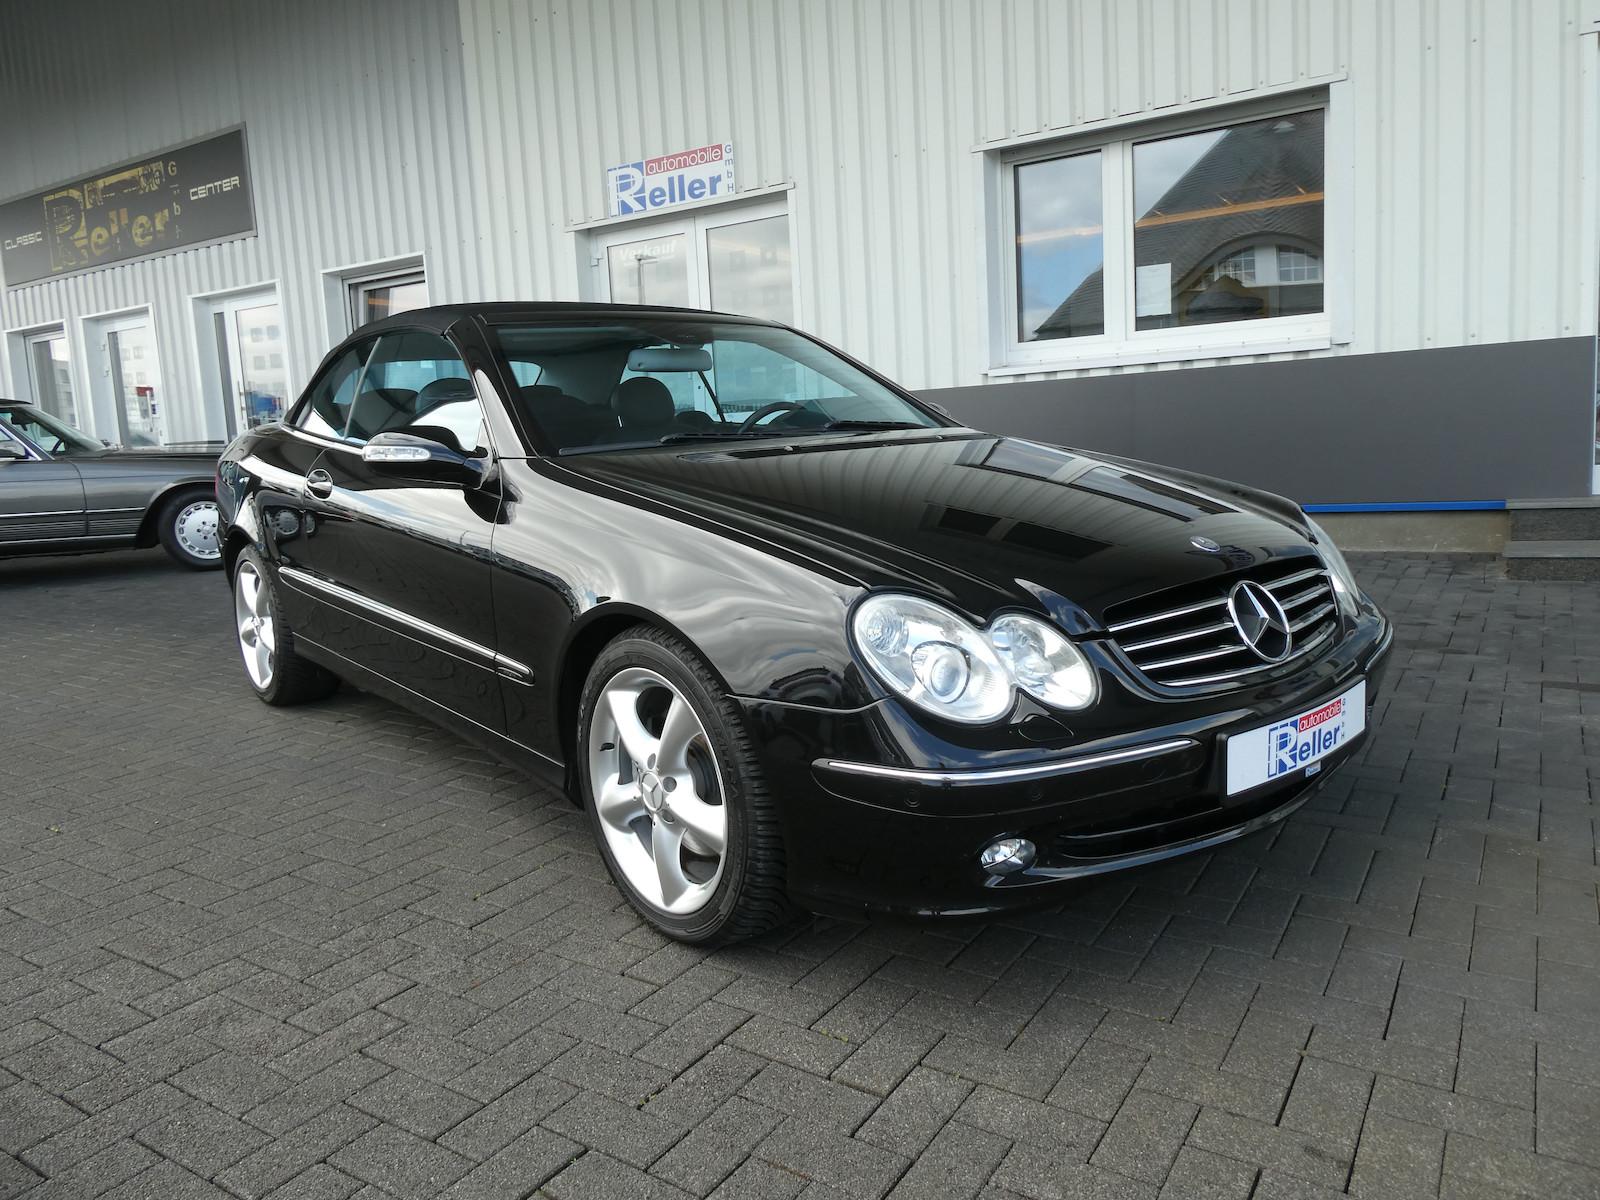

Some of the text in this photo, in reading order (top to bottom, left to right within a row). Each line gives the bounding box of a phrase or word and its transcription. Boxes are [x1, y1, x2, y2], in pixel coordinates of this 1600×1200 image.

[646, 147, 721, 175] automobile
[724, 144, 734, 193] GmbH
[189, 175, 241, 201] CENTER
[607, 161, 722, 217] Reller
[1299, 701, 1341, 732] automobile
[1267, 718, 1340, 778] Reller
